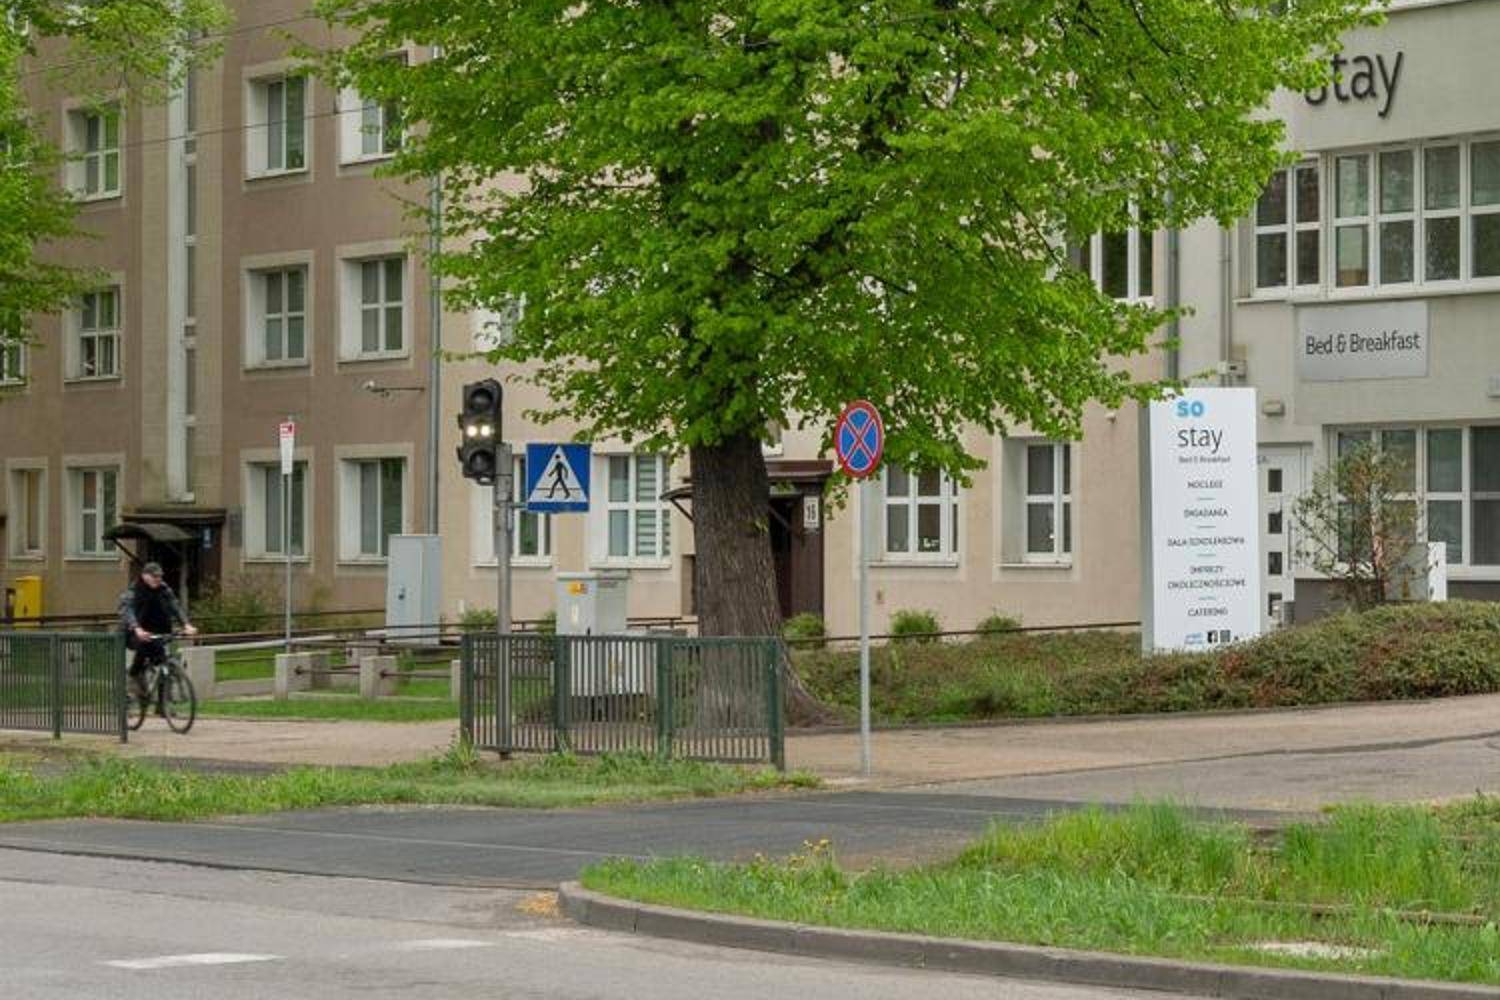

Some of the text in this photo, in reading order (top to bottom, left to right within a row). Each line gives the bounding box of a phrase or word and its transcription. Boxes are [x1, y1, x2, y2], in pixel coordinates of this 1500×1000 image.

[1305, 329, 1421, 355] Bed & Breakfast
[1177, 427, 1223, 454] stay
